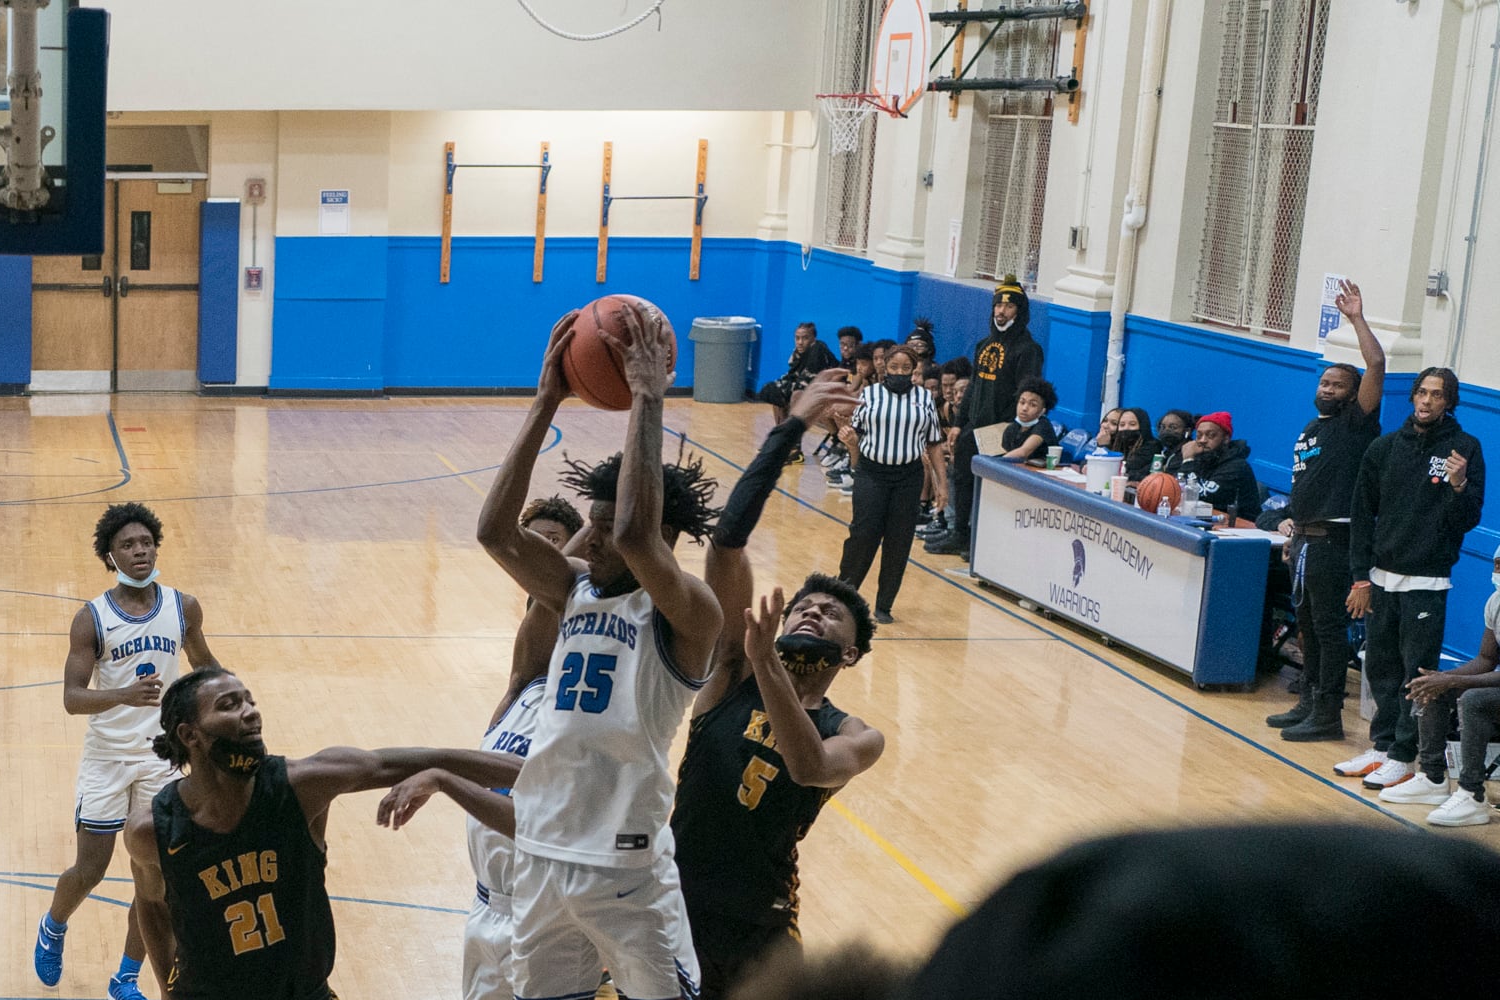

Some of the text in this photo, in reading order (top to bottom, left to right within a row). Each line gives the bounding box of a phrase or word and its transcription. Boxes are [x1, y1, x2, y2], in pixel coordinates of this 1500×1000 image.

[1325, 279, 1341, 291] STO
[1015, 508, 1154, 580] RICHARDS CAREER ACADEMY
[1050, 582, 1100, 624] WARRIORS
[111, 635, 177, 662] RICHARDS
[554, 651, 618, 714] 25
[737, 755, 780, 811] 5
[198, 850, 278, 900] KING
[224, 893, 286, 956] 21
